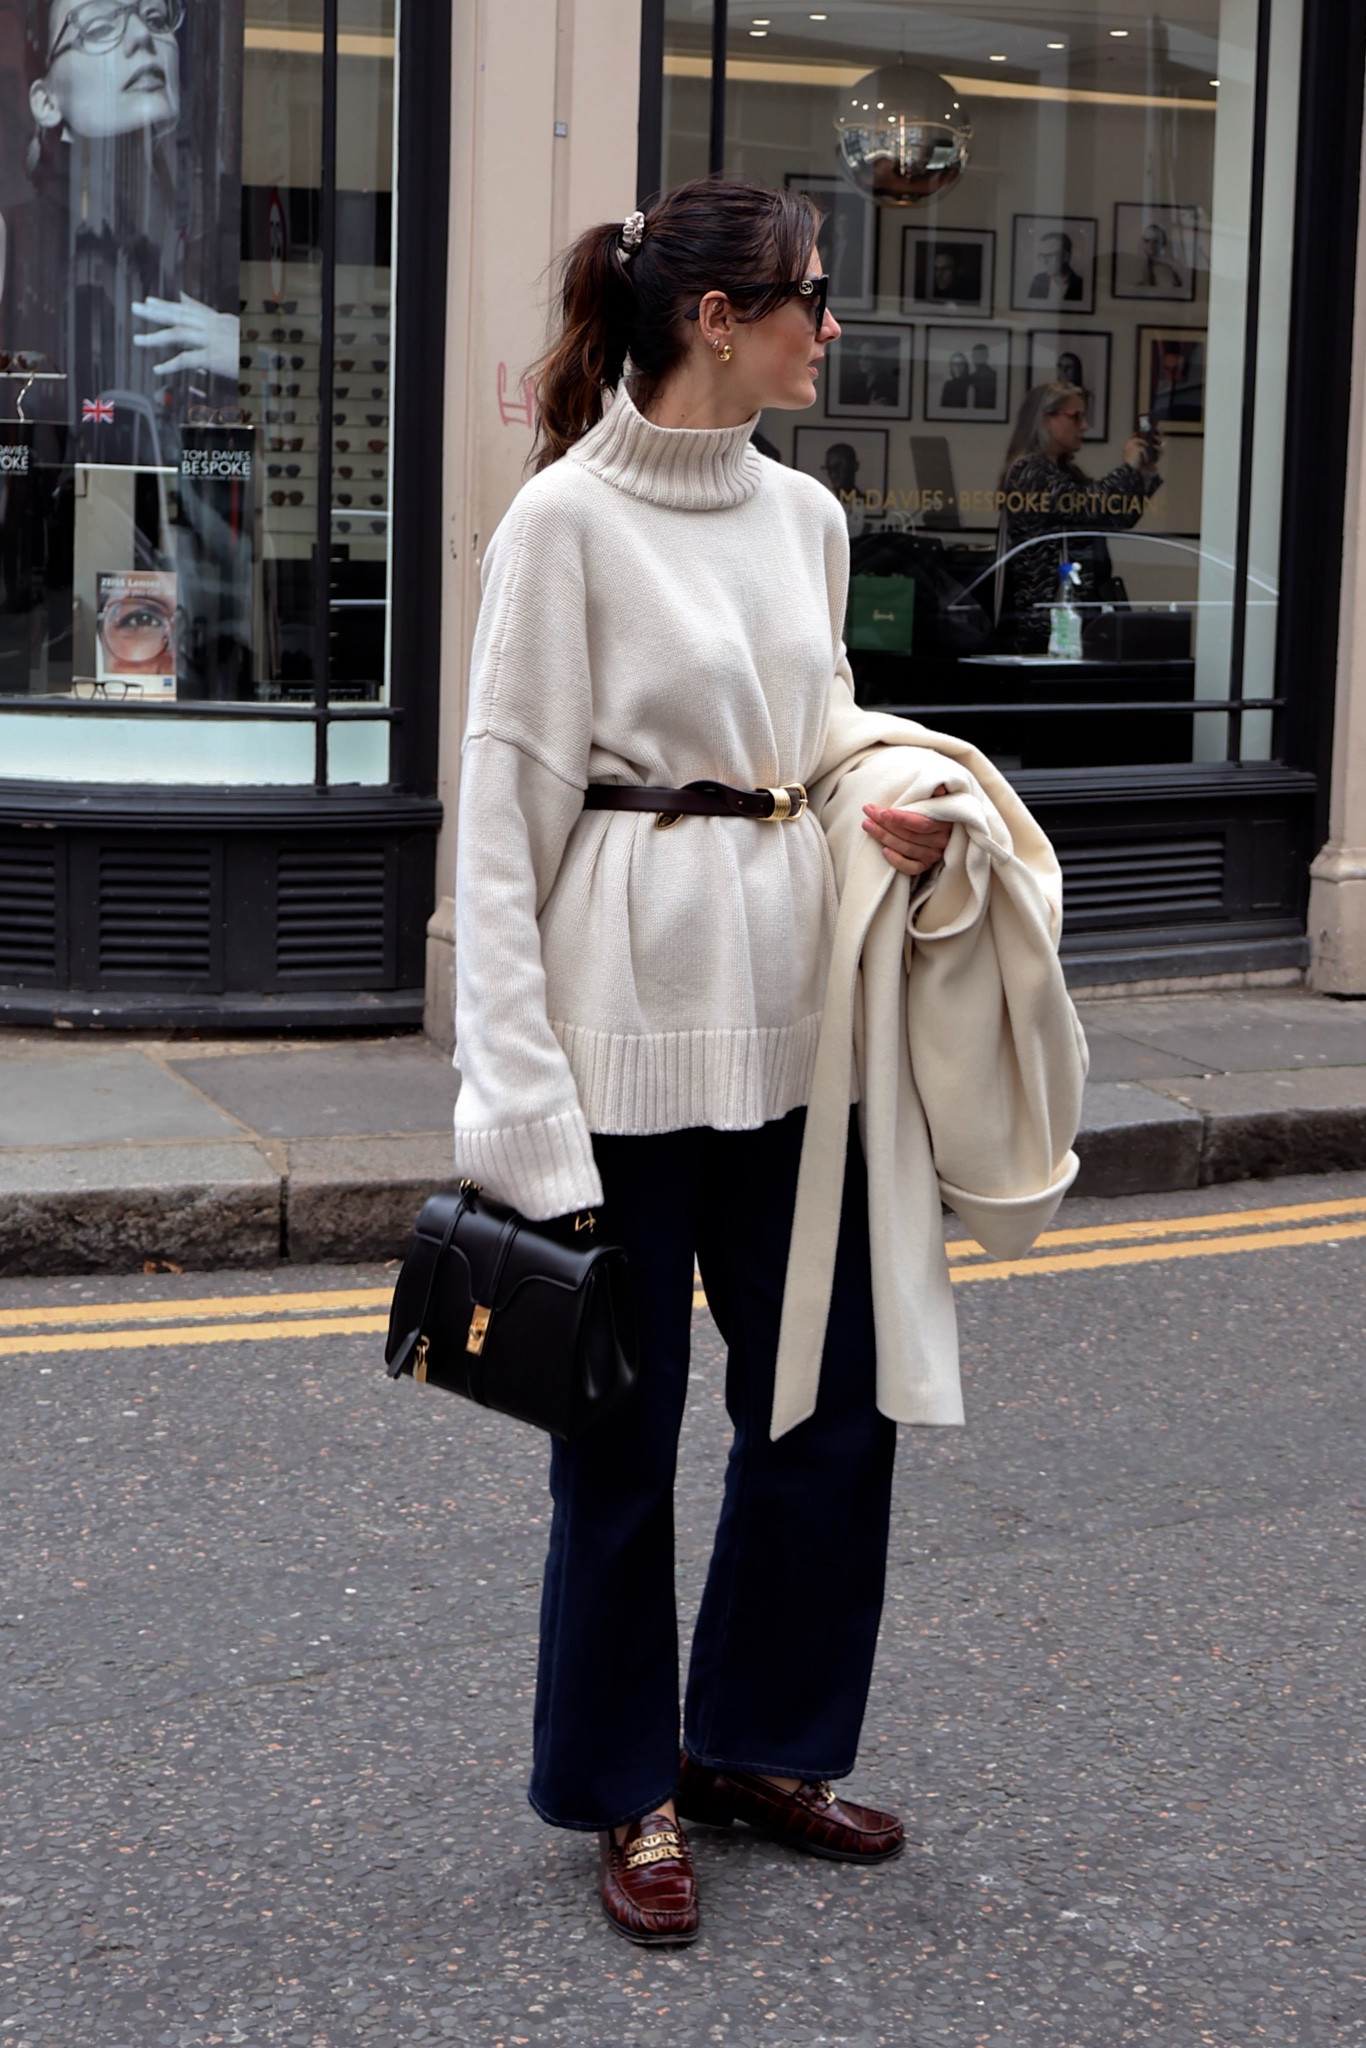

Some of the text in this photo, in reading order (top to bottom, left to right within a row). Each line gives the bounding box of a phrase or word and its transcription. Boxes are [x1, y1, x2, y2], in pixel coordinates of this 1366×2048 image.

[182, 449, 251, 461] TOM DAVIES
[181, 461, 251, 475] BESPOKE
[865, 488, 944, 512] DAVIES
[959, 489, 1050, 513] BESPOKE
